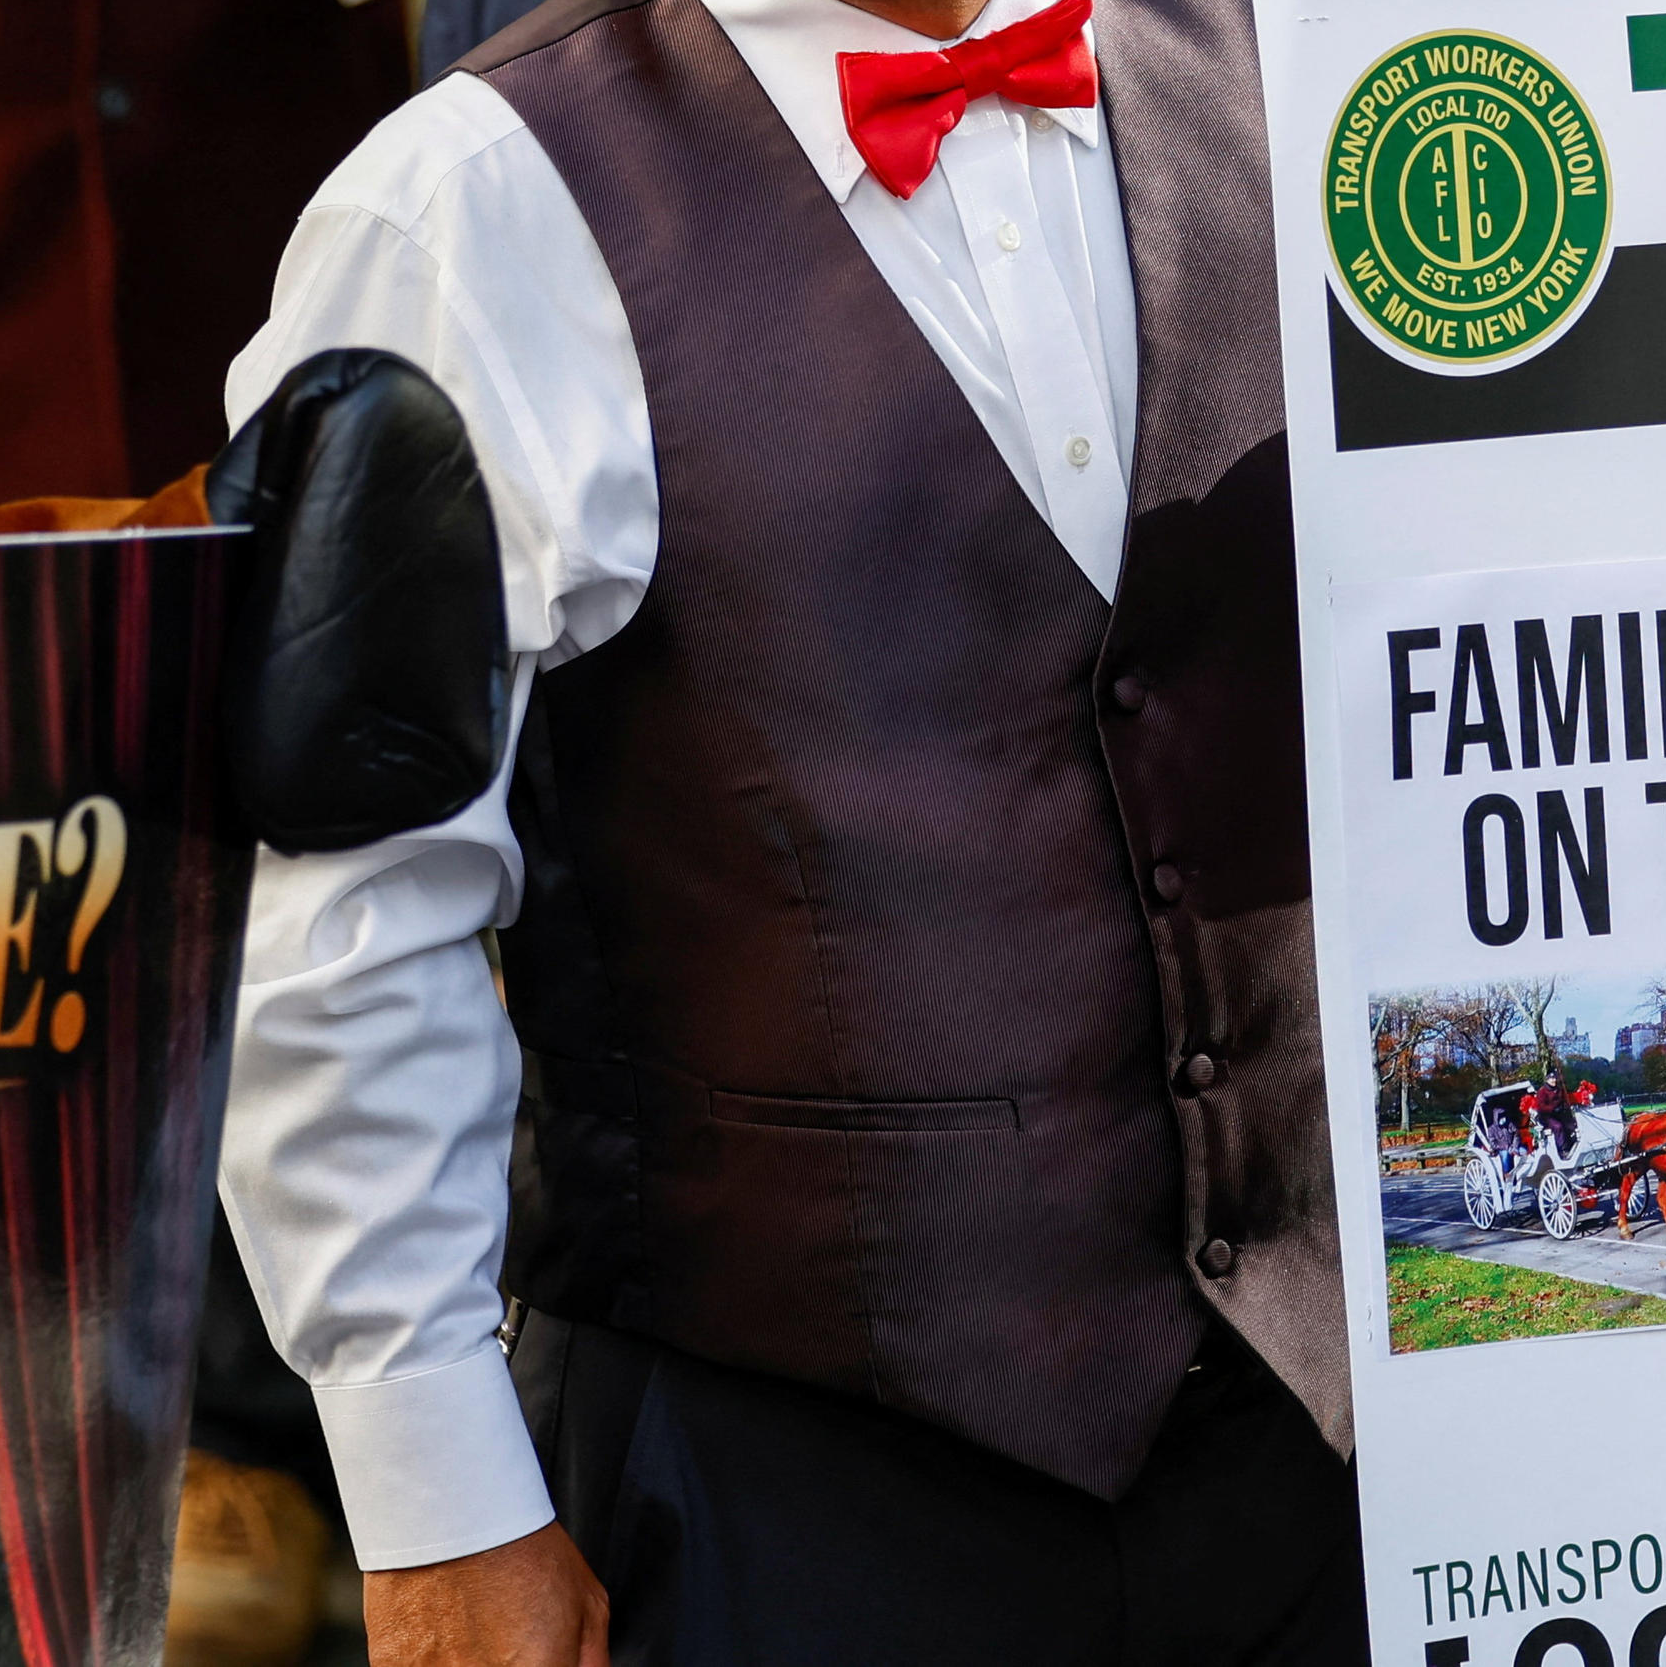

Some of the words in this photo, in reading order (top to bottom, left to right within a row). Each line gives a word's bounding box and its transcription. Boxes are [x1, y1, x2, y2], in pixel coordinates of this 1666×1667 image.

[1335, 54, 1421, 214] TRANSPORT
[1423, 44, 1554, 108] WORKERS
[1547, 99, 1598, 197] UNION
[1405, 95, 1471, 136] LOCAL
[1475, 98, 1511, 132] 100
[1349, 248, 1389, 303] WE
[1381, 292, 1459, 350] MOVE
[1465, 302, 1528, 349] NEW
[1524, 237, 1589, 316] YORK
[1415, 262, 1467, 297] EST.
[1472, 255, 1525, 296] 1934
[1463, 785, 1612, 947] ON
